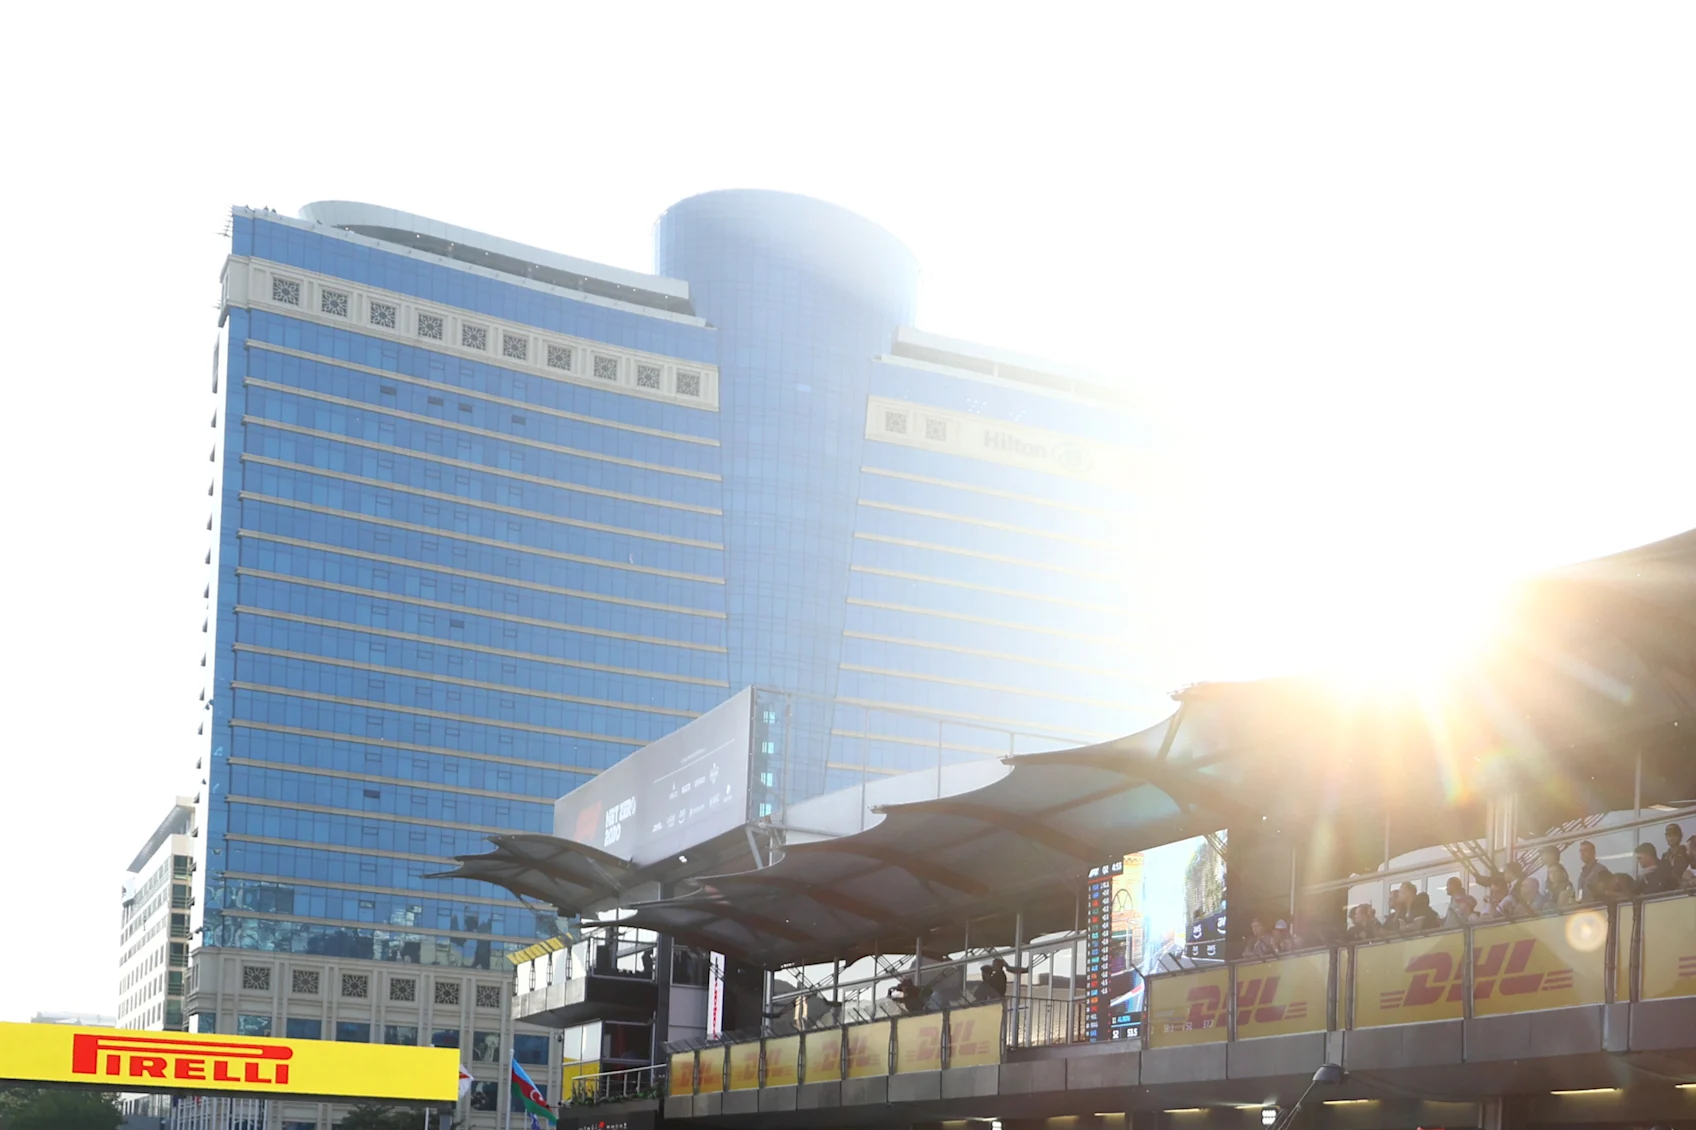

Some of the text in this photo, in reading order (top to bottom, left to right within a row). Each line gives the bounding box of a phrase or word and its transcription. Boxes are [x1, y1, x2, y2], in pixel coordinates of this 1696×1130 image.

[983, 429, 1049, 459] Hilton
[1404, 939, 1543, 1010] DHL
[1186, 975, 1288, 1029] DHL
[72, 1033, 294, 1085] PIRELLI
[914, 1016, 984, 1067] DHL
